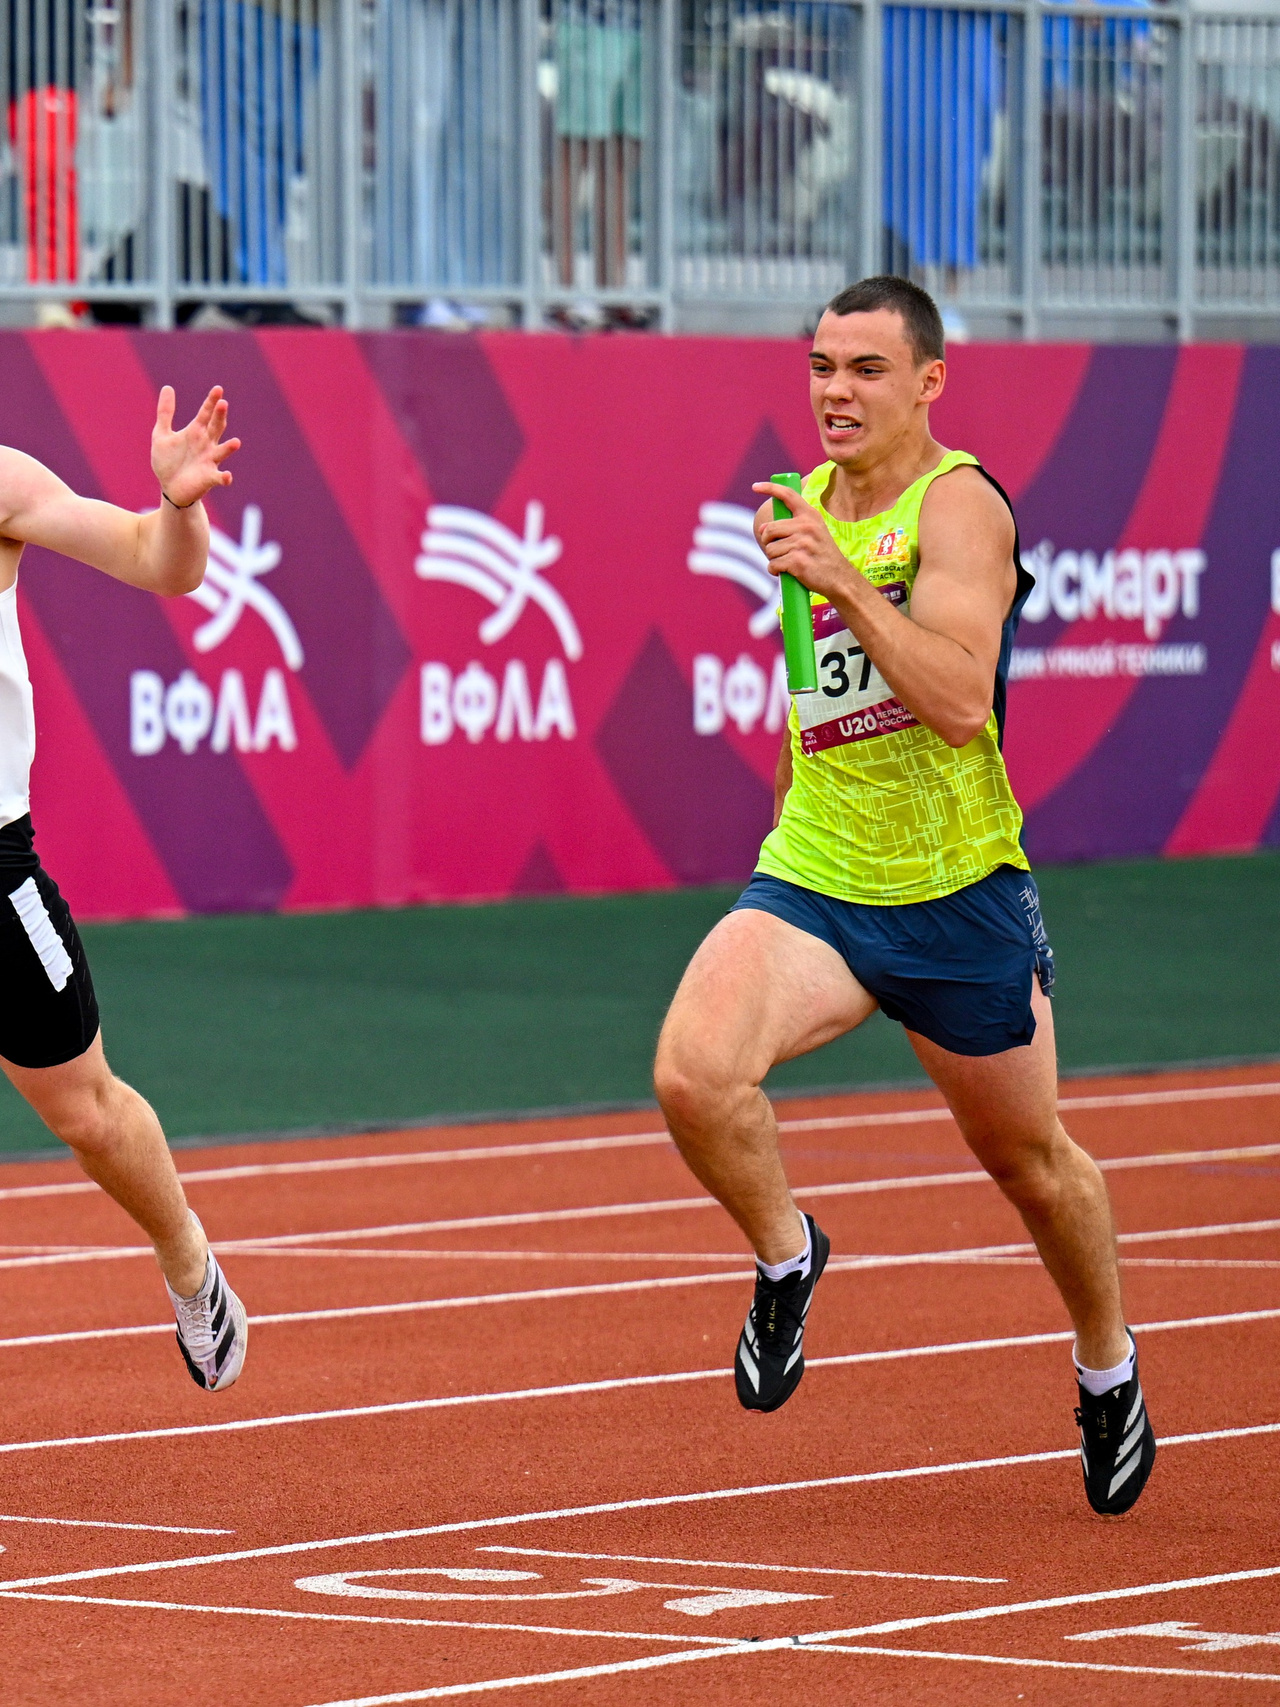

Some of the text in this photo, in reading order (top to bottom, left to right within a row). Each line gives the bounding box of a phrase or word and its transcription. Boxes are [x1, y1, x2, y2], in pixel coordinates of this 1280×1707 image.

[420, 657, 577, 744] ВФЛА
[820, 645, 873, 698] 37
[130, 667, 297, 755] ВФЛА
[838, 713, 877, 737] U20
